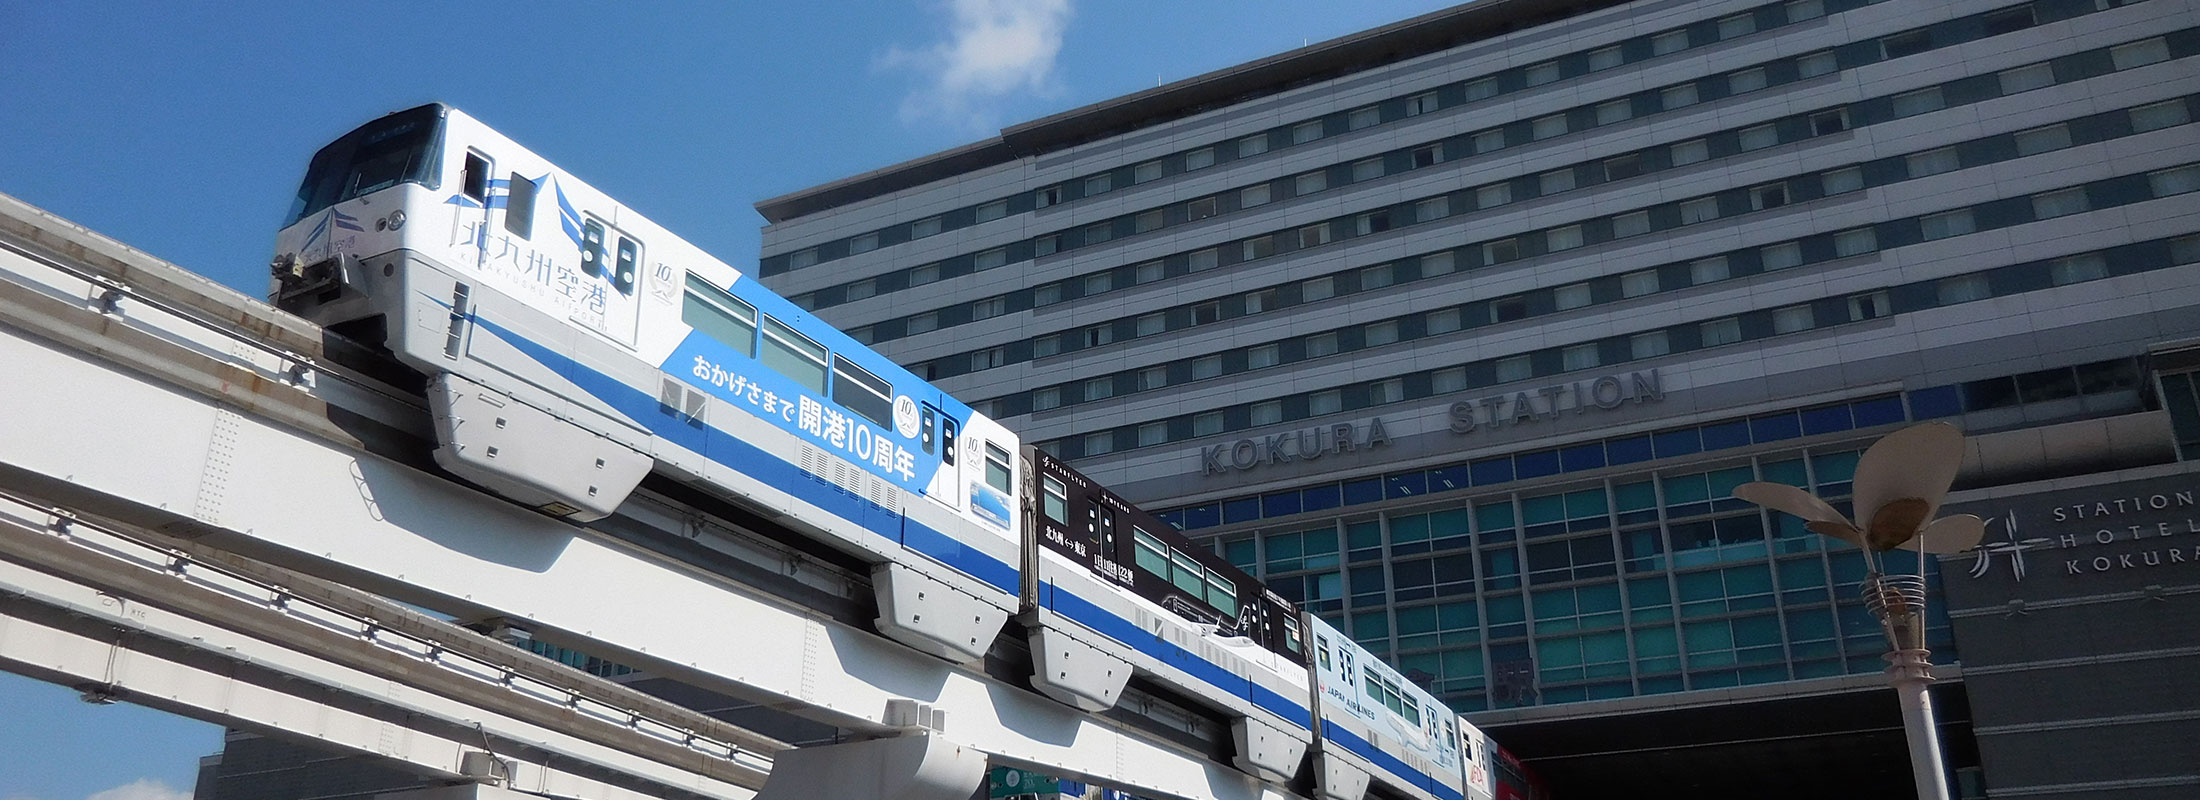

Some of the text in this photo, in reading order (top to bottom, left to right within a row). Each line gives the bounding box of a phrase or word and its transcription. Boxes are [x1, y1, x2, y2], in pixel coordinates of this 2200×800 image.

[459, 221, 607, 316] 北九州空港
[459, 254, 546, 297] KIAKYUSHU
[1199, 367, 1666, 476] KOKURA STATION
[2053, 490, 2195, 523] STATION
[2060, 518, 2200, 549] HOTEL
